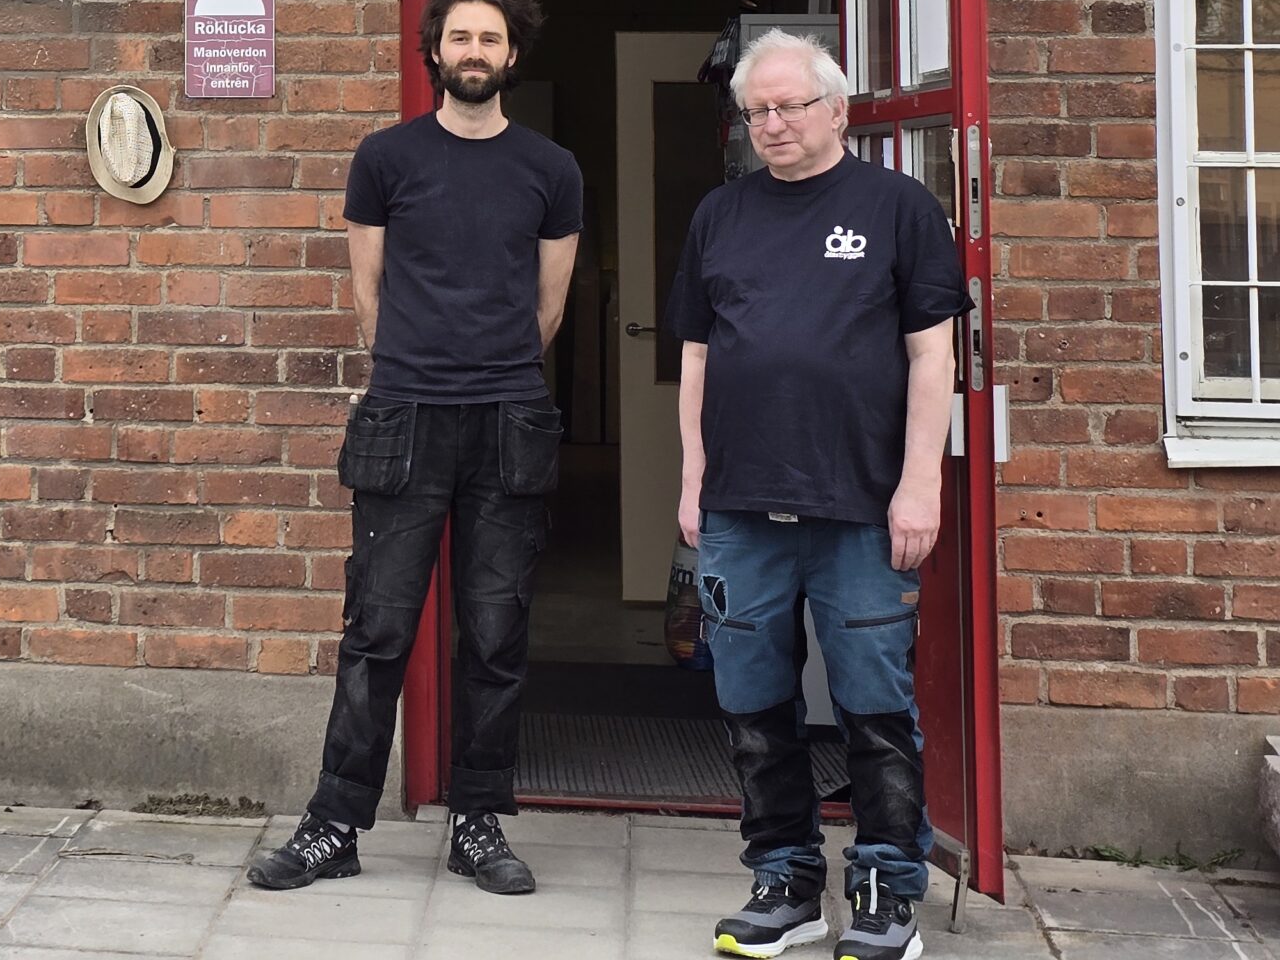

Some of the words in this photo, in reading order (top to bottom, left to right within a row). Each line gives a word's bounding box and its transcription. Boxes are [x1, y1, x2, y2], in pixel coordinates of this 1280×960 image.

[194, 21, 265, 34] Röklucka
[193, 46, 266, 58] Manöverdon
[210, 77, 249, 88] entrén
